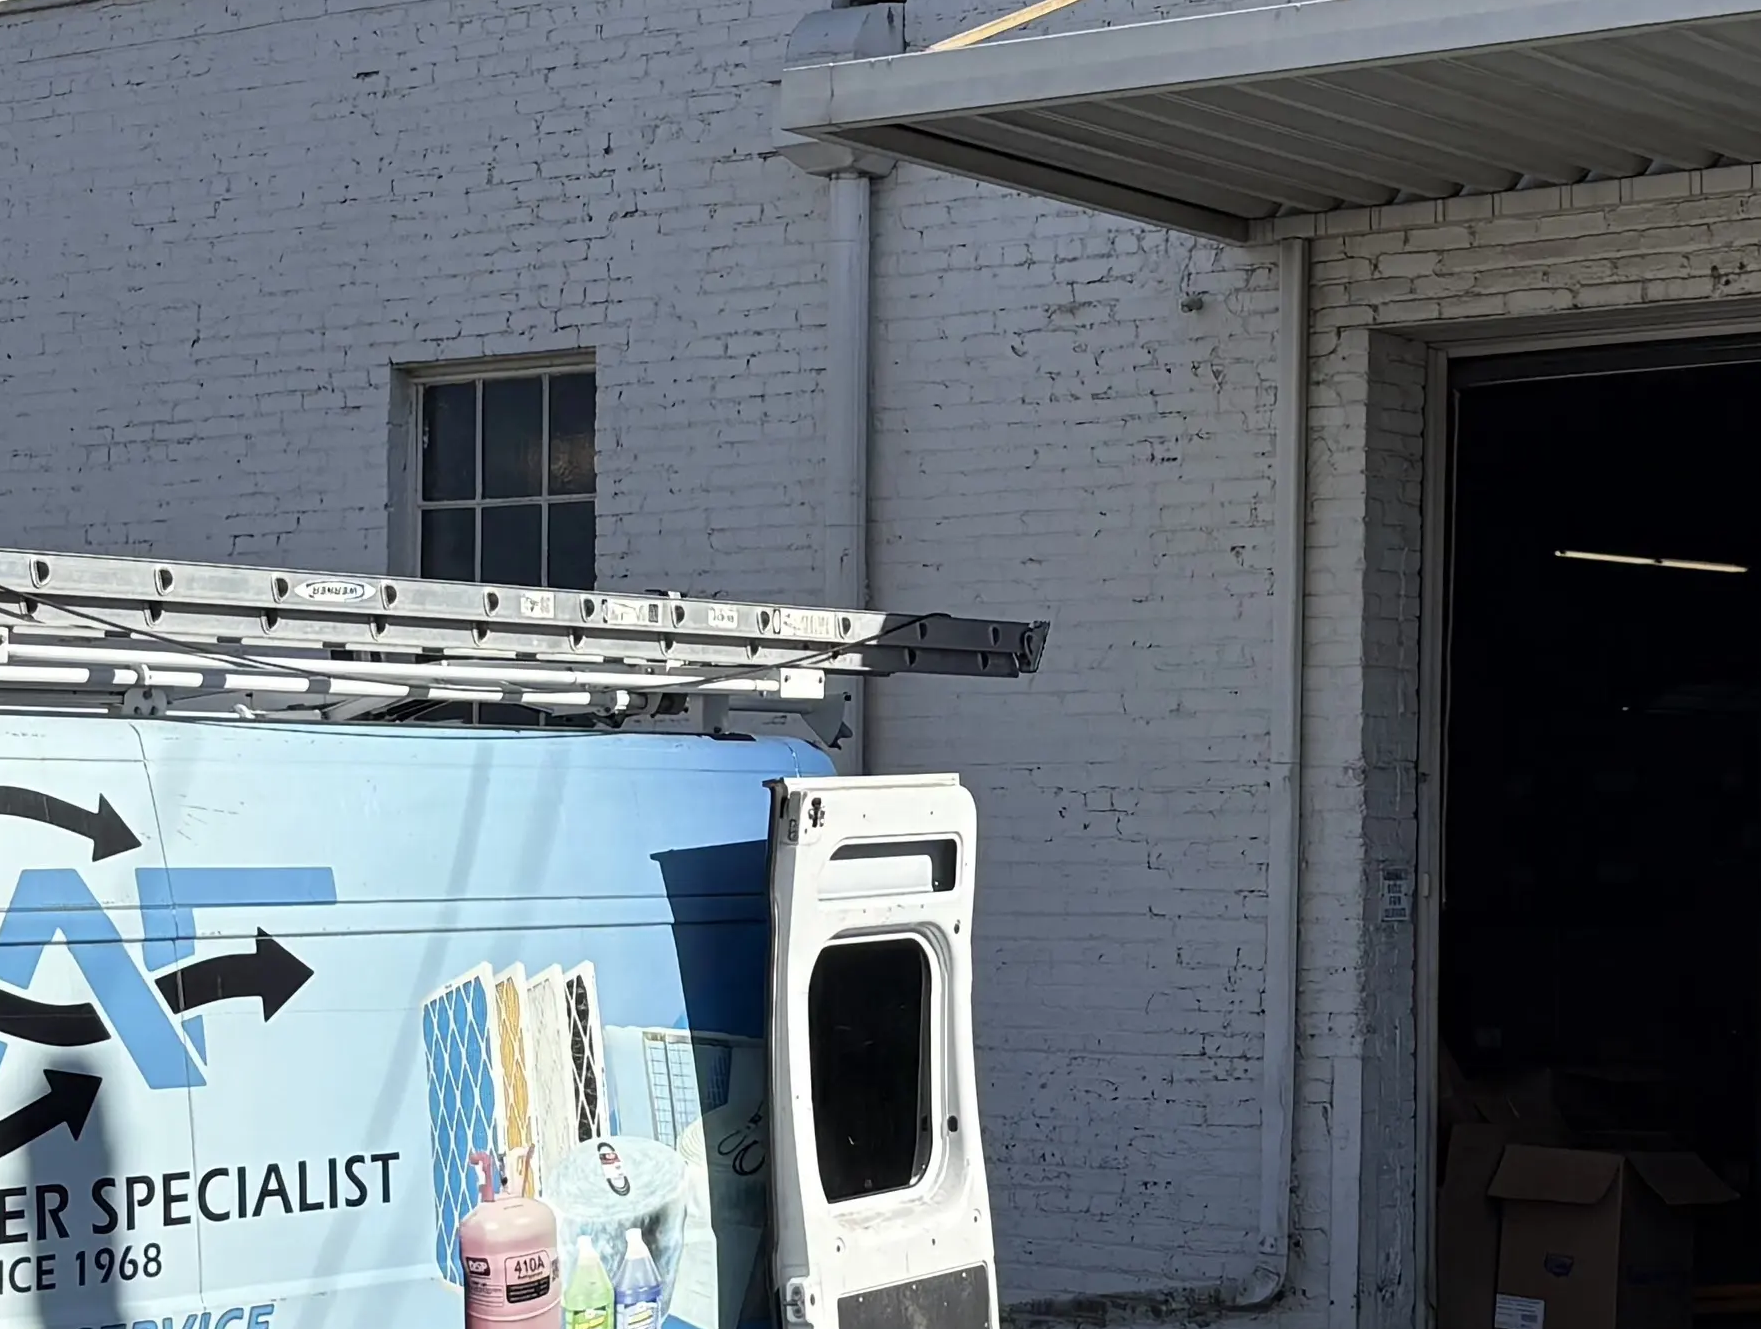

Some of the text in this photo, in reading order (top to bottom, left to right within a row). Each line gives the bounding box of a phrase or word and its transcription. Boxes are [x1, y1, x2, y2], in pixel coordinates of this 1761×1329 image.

[312, 586, 358, 596] WERNER
[91, 1152, 400, 1236] SPECIALIST
[73, 1242, 162, 1287] 1968
[513, 1255, 545, 1274] 410A
